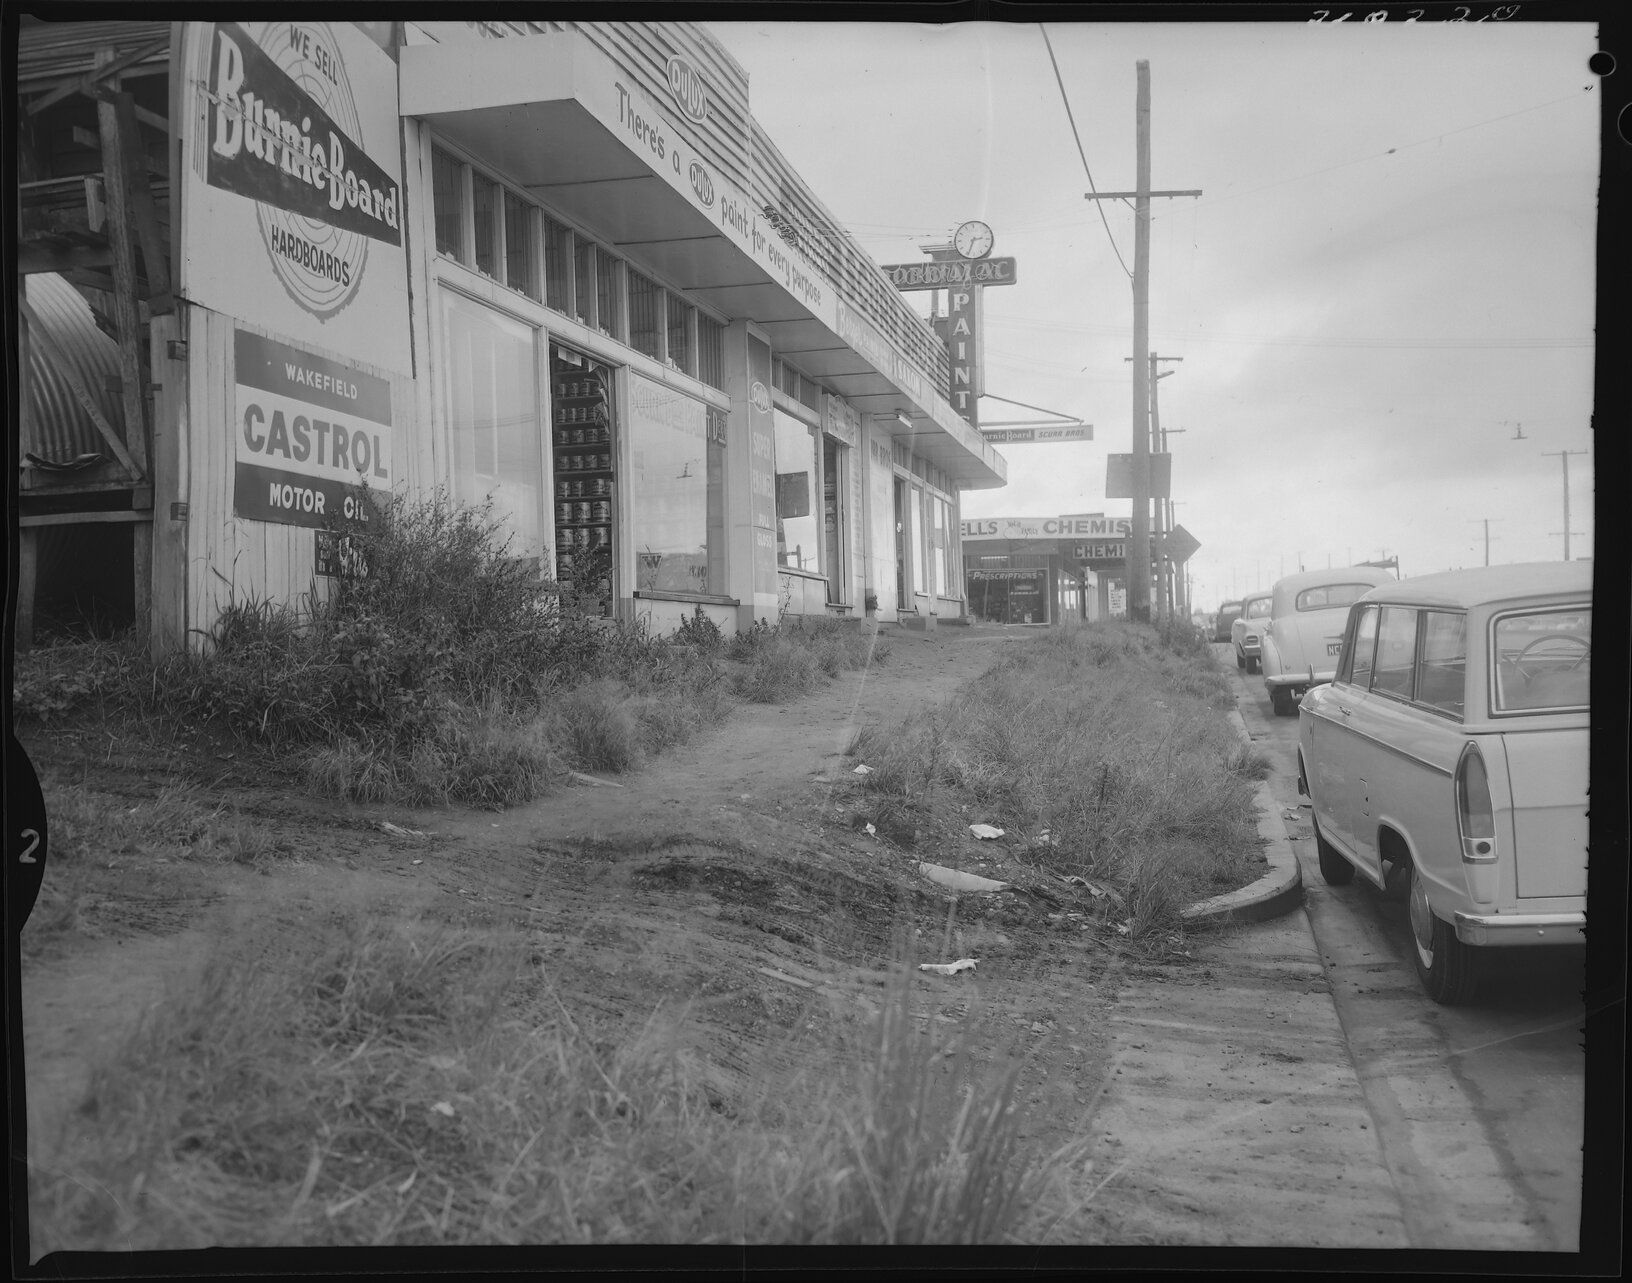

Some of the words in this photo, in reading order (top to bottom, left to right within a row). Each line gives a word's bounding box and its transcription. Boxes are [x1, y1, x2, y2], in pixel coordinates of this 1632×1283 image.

[290, 24, 311, 60] WE
[315, 45, 338, 87] SELL
[614, 81, 665, 160] There's
[672, 150, 681, 176] a
[720, 195, 750, 239] paint
[751, 216, 767, 255] for
[768, 244, 791, 287] every
[792, 268, 822, 307] purpose
[271, 223, 350, 288] HARDBOARDS
[952, 293, 971, 422] PAINT
[285, 362, 358, 400] WAKEFIELD
[243, 403, 389, 480] CASTROL
[982, 429, 1006, 441] urnie
[269, 482, 326, 514] MOTOR
[343, 496, 369, 522] OIL
[1042, 519, 1131, 534] CHEMIS
[1074, 544, 1123, 558] CHEMI
[19, 828, 40, 863] 2
